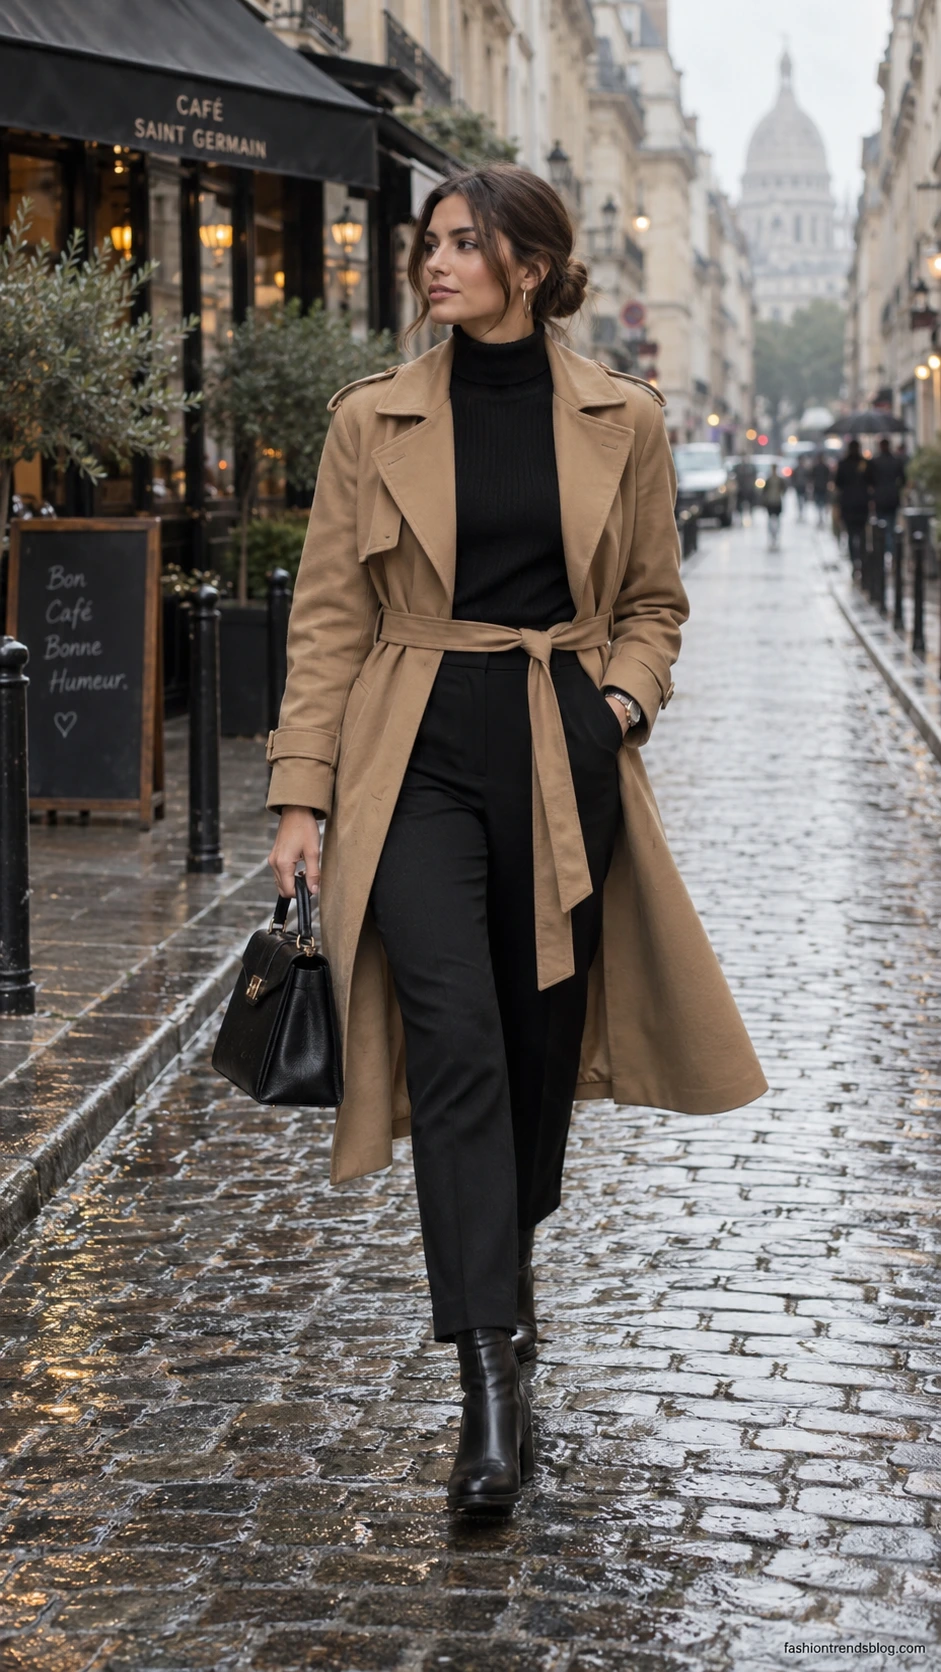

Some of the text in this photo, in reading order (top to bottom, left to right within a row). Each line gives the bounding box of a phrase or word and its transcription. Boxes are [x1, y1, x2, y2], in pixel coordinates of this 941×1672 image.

[176, 94, 224, 122] CAFÉ
[134, 118, 267, 159] SAINT GERMAIN
[46, 565, 87, 590] Bon
[45, 596, 93, 630] Café
[44, 634, 102, 660] Bonne
[49, 668, 128, 693] Humeur.
